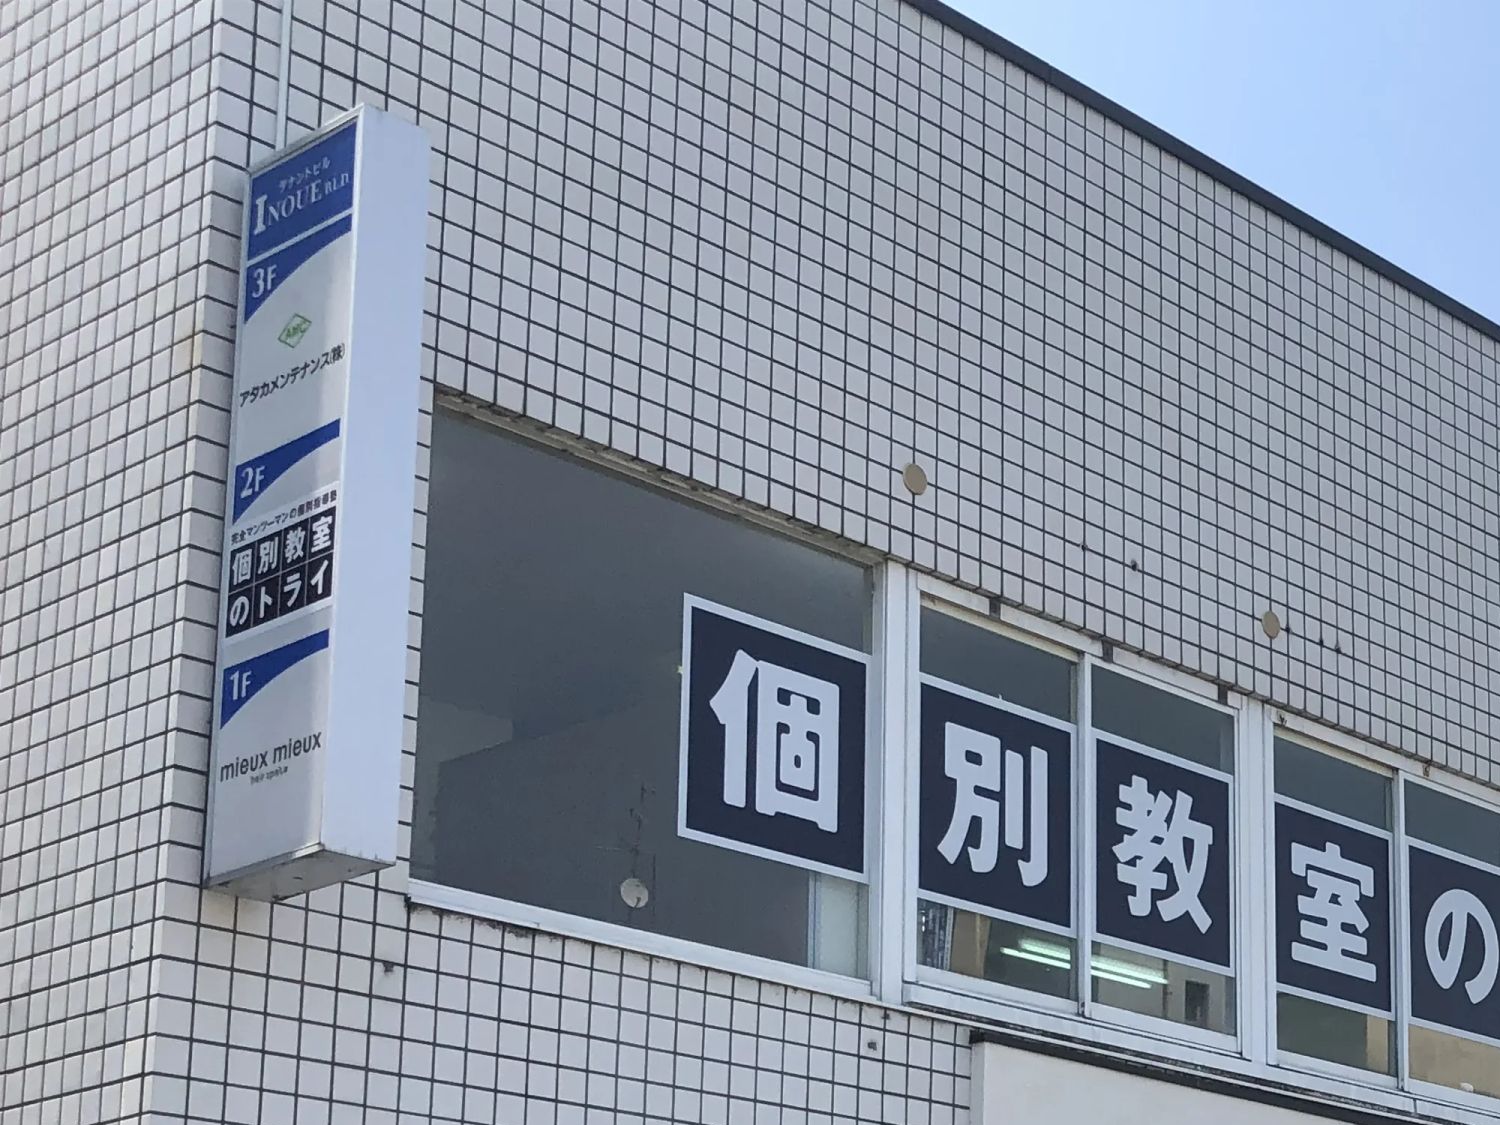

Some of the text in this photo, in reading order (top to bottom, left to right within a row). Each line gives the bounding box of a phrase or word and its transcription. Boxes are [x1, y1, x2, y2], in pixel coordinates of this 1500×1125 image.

[278, 156, 330, 192] テナントビル
[253, 179, 322, 235] INOUE
[252, 264, 277, 298] 3F
[240, 465, 265, 499] 2F
[232, 515, 333, 586] 個別教室
[229, 559, 329, 627] のトライ
[230, 670, 252, 701] 1F
[220, 732, 322, 782] mieux mieux
